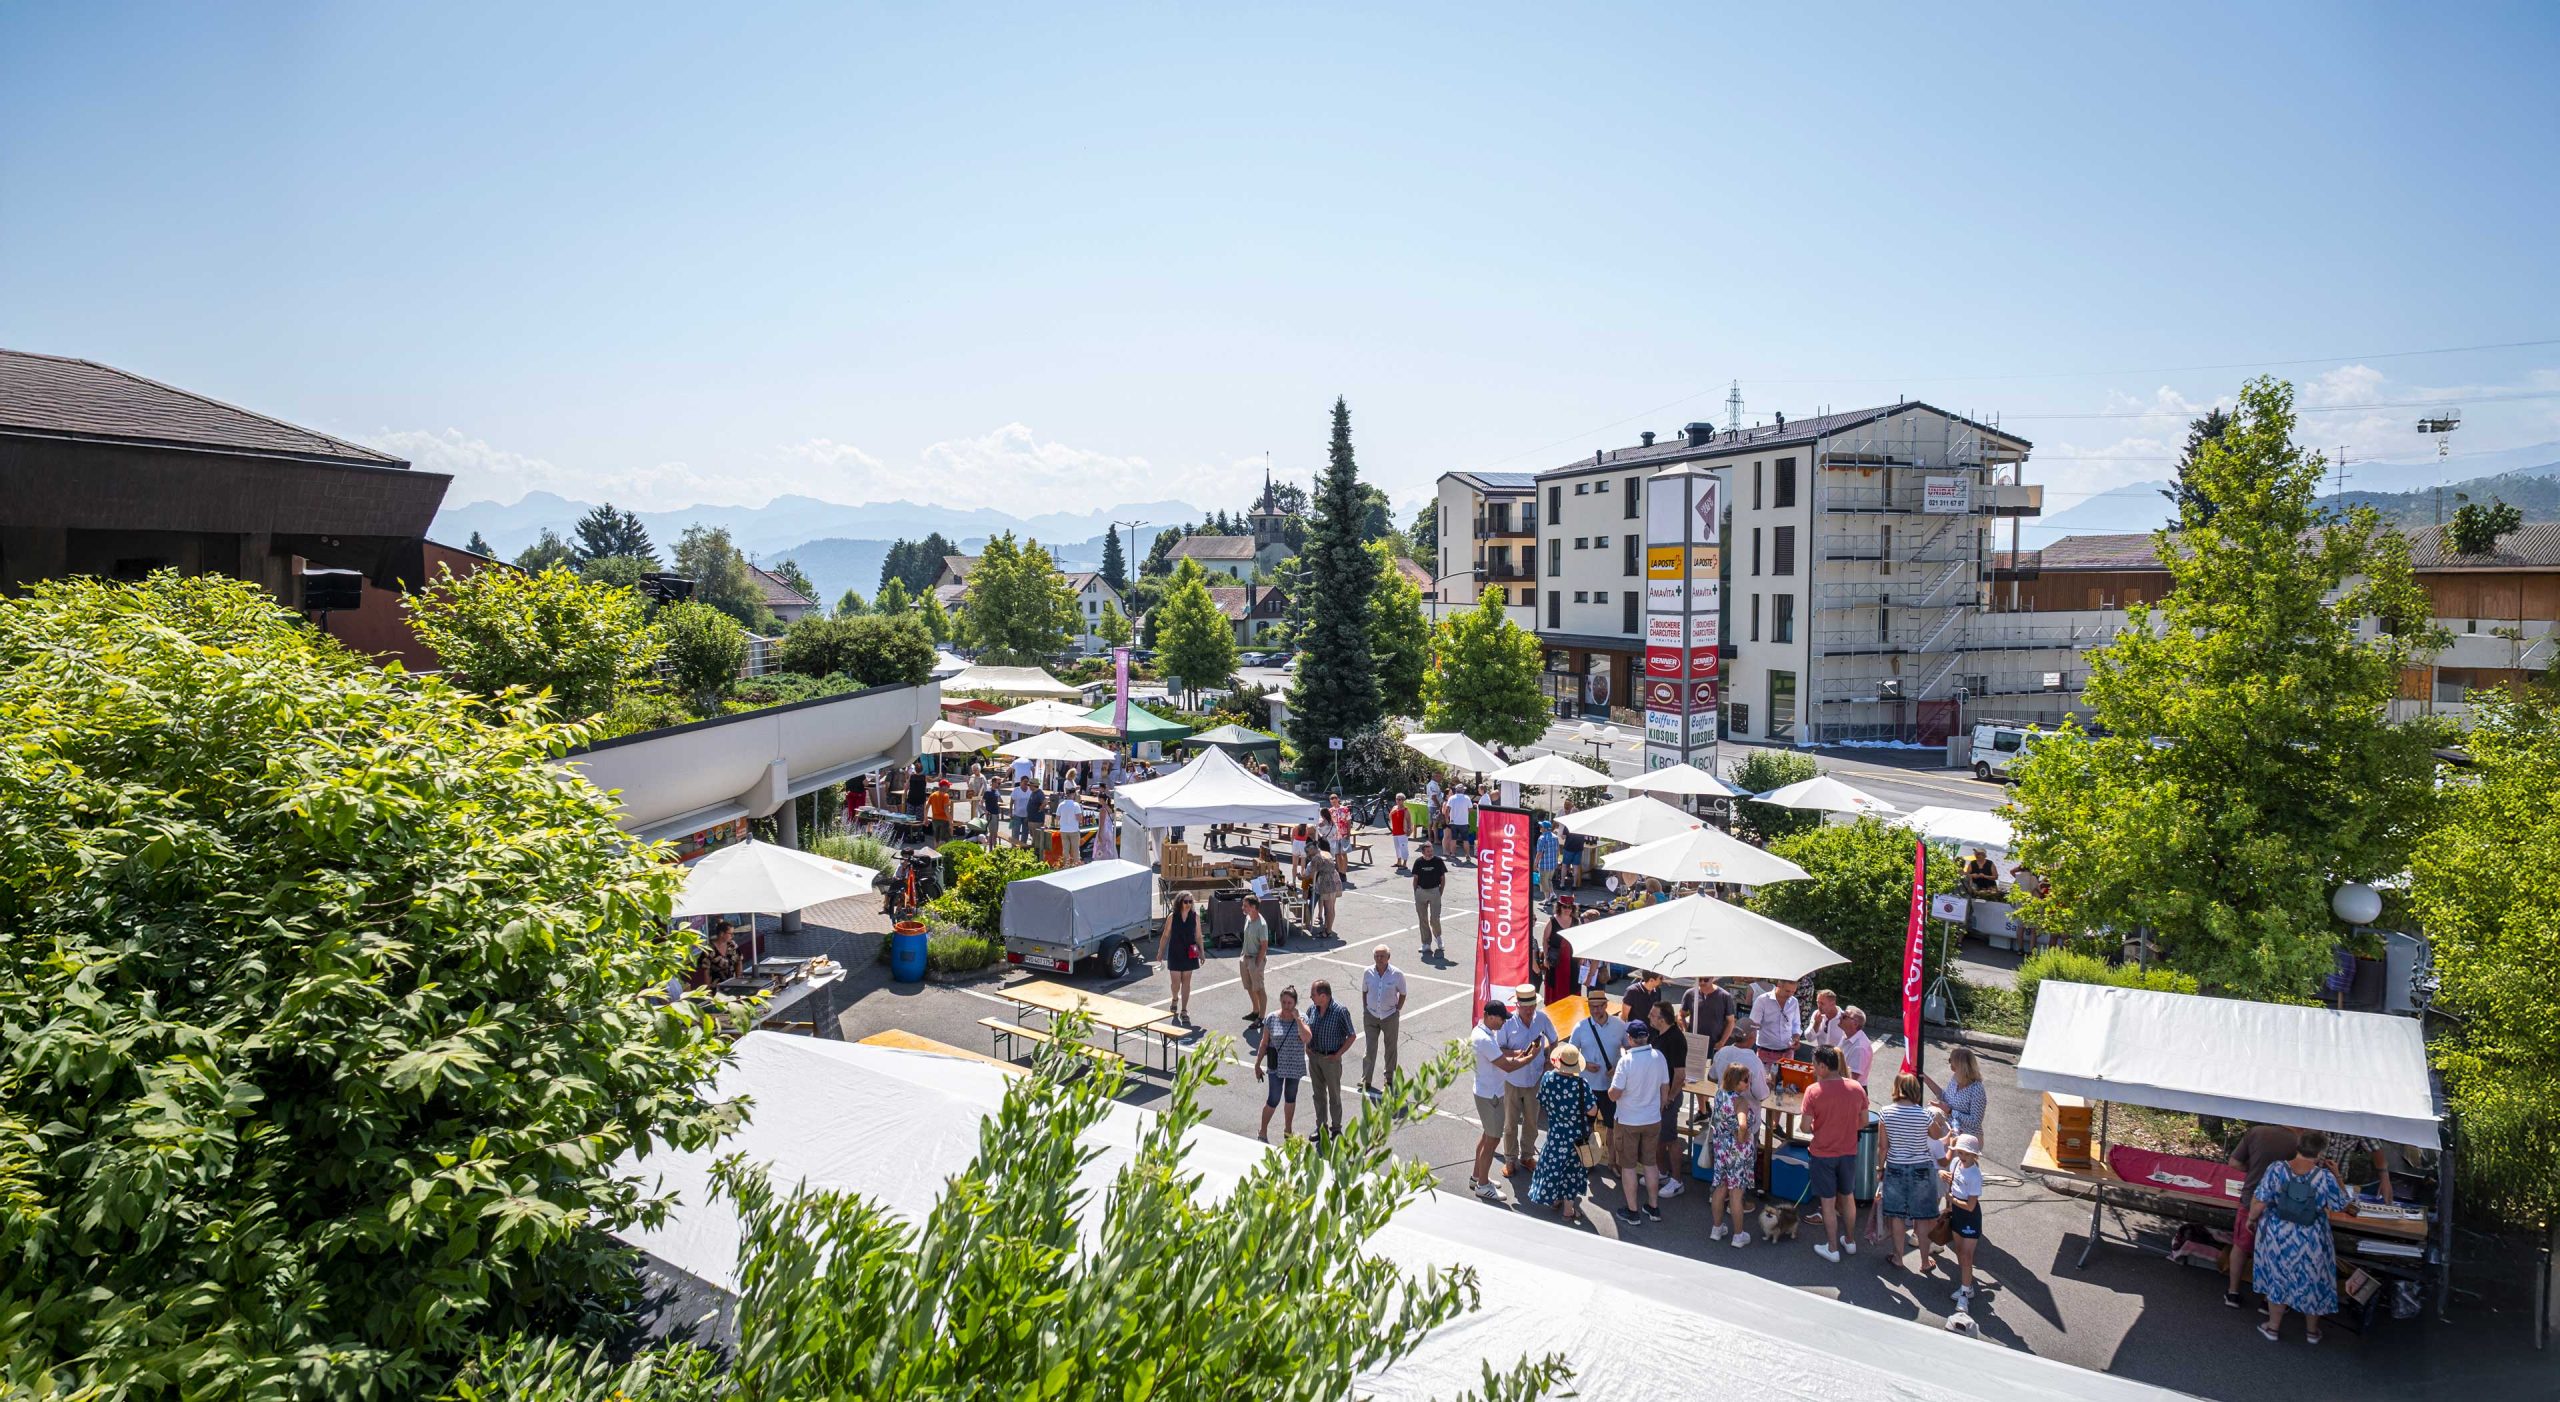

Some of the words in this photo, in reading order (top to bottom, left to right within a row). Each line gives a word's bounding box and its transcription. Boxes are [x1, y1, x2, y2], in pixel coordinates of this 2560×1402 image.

[1651, 560, 1659, 568] LA
[1659, 559, 1675, 568] POSTE
[1694, 559, 1700, 567] LA
[1700, 558, 1713, 567] POSTE
[1656, 621, 1680, 629] BOUCHERIE
[1697, 620, 1716, 628] BOUCHERIE
[1650, 628, 1680, 638] CHARCUTERIE
[1693, 629, 1716, 637] CHARCUTERIE
[1651, 656, 1677, 666] DENNER
[1694, 656, 1713, 665] DENNER
[1649, 712, 1678, 728] Coiffure
[1691, 715, 1715, 730] Coiffure
[1649, 728, 1678, 744] KIOSQUE
[1691, 729, 1715, 745] KIOSQUE
[1699, 756, 1715, 770] BCV
